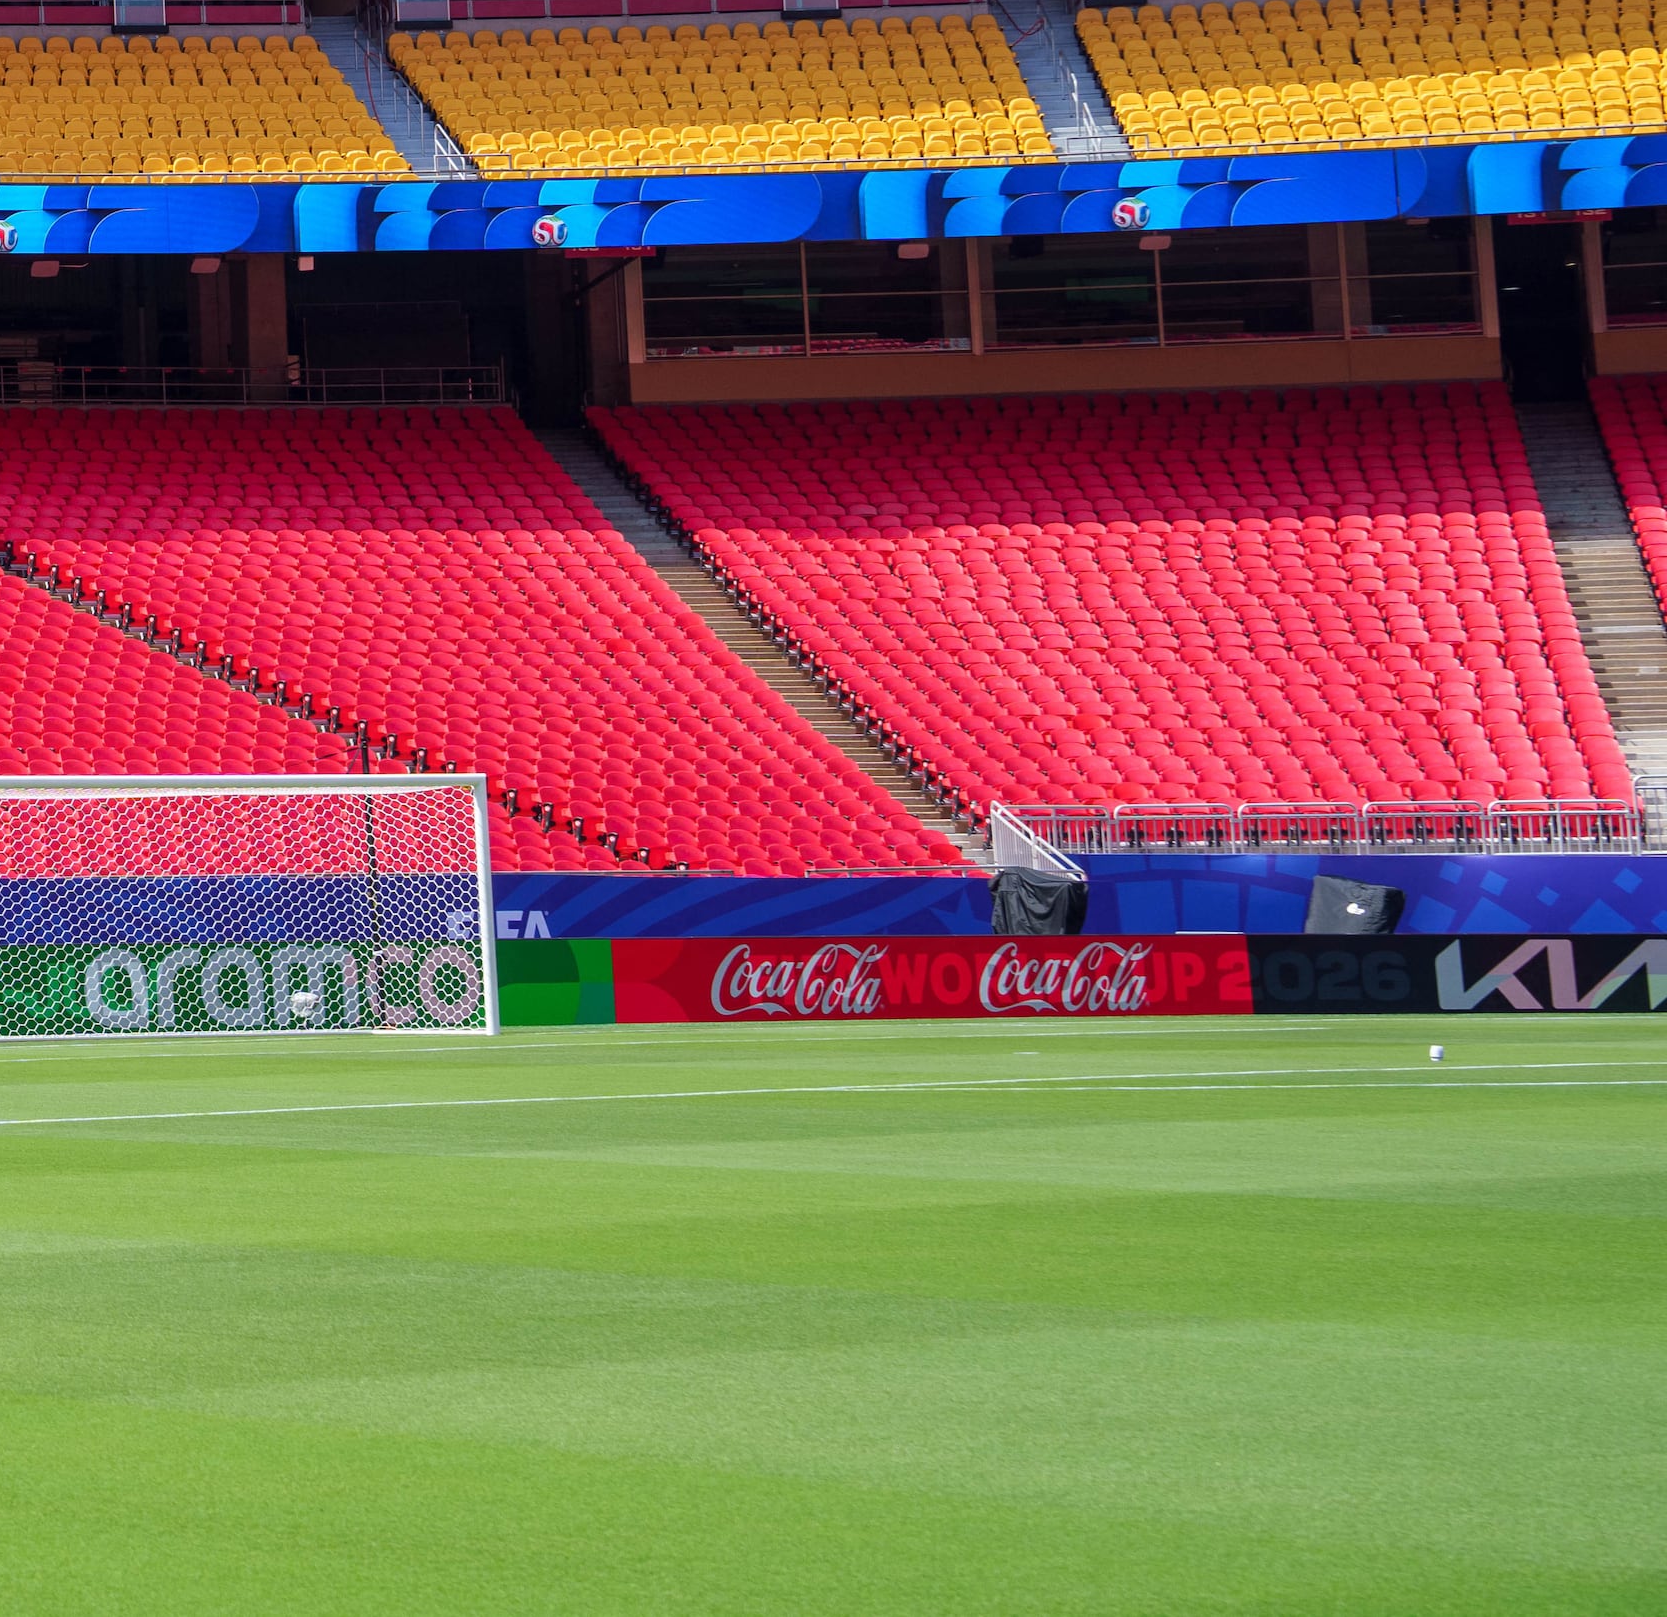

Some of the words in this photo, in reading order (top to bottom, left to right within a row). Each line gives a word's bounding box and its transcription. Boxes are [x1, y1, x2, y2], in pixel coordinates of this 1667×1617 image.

[446, 910, 552, 939] FFA
[85, 943, 481, 1029] aramco
[710, 943, 889, 1016] Coca-Cola
[979, 941, 1154, 1013] Coca-Cola
